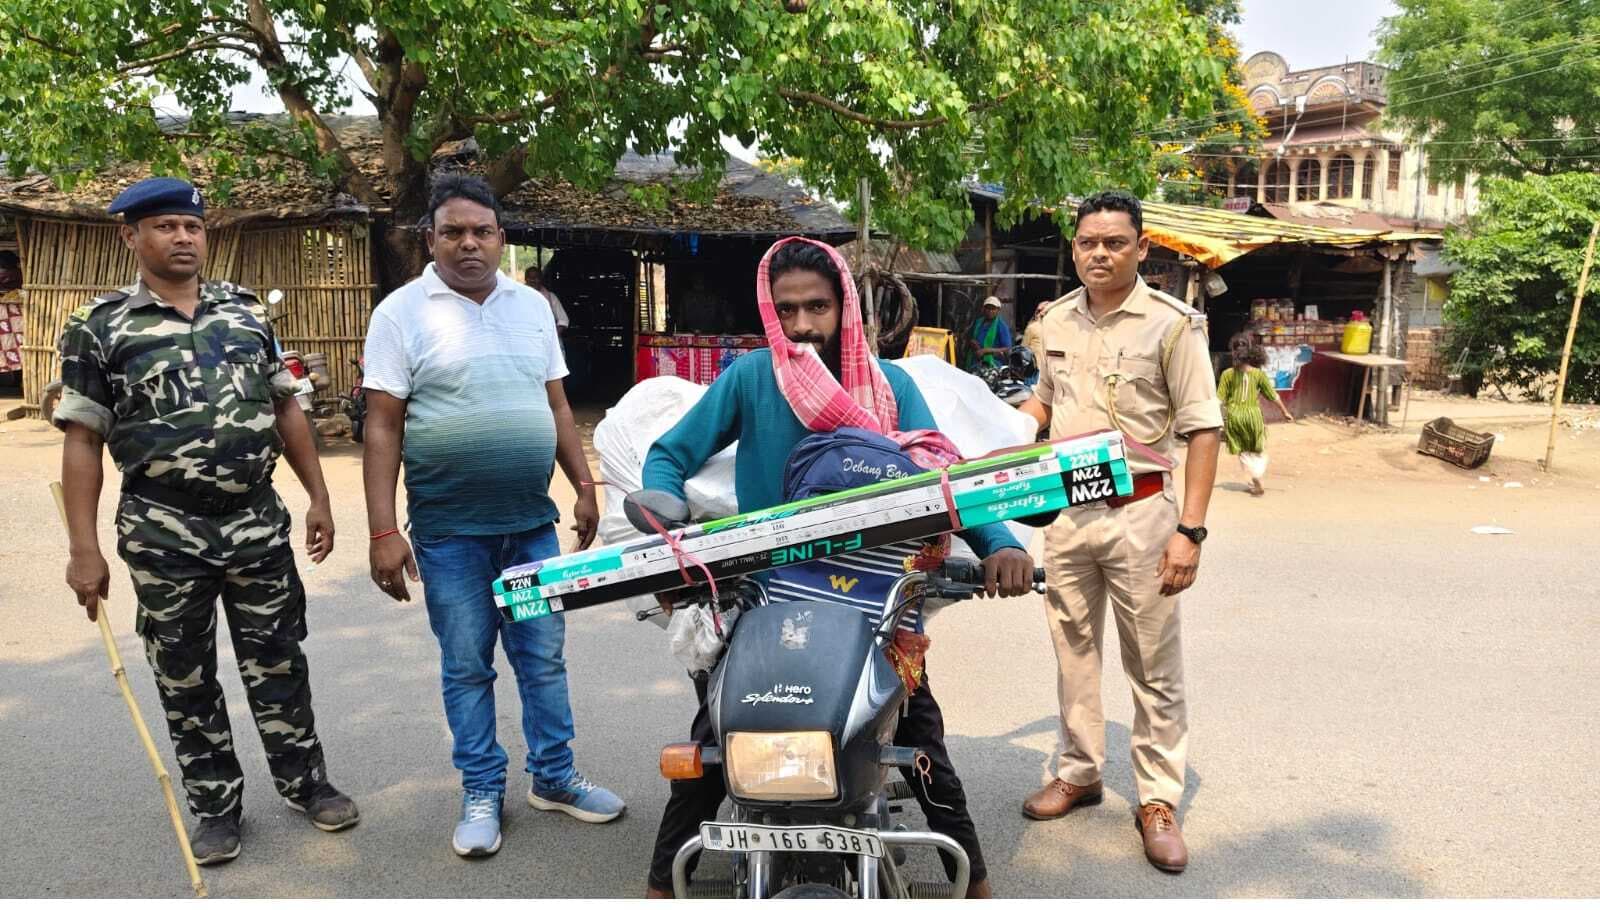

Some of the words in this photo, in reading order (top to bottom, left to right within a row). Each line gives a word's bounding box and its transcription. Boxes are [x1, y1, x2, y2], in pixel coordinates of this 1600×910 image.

[842, 457, 881, 479] Debang
[1072, 465, 1102, 482] 22W
[1071, 478, 1113, 503] 22W
[987, 493, 1047, 518] fybros
[771, 533, 862, 566] F-LINE
[510, 577, 532, 591] 22W
[511, 590, 534, 603] 22W
[516, 600, 547, 619] 22W
[785, 685, 812, 694] Hero
[727, 830, 748, 849] JH
[769, 832, 807, 849] 16G
[824, 831, 874, 855] 6381
